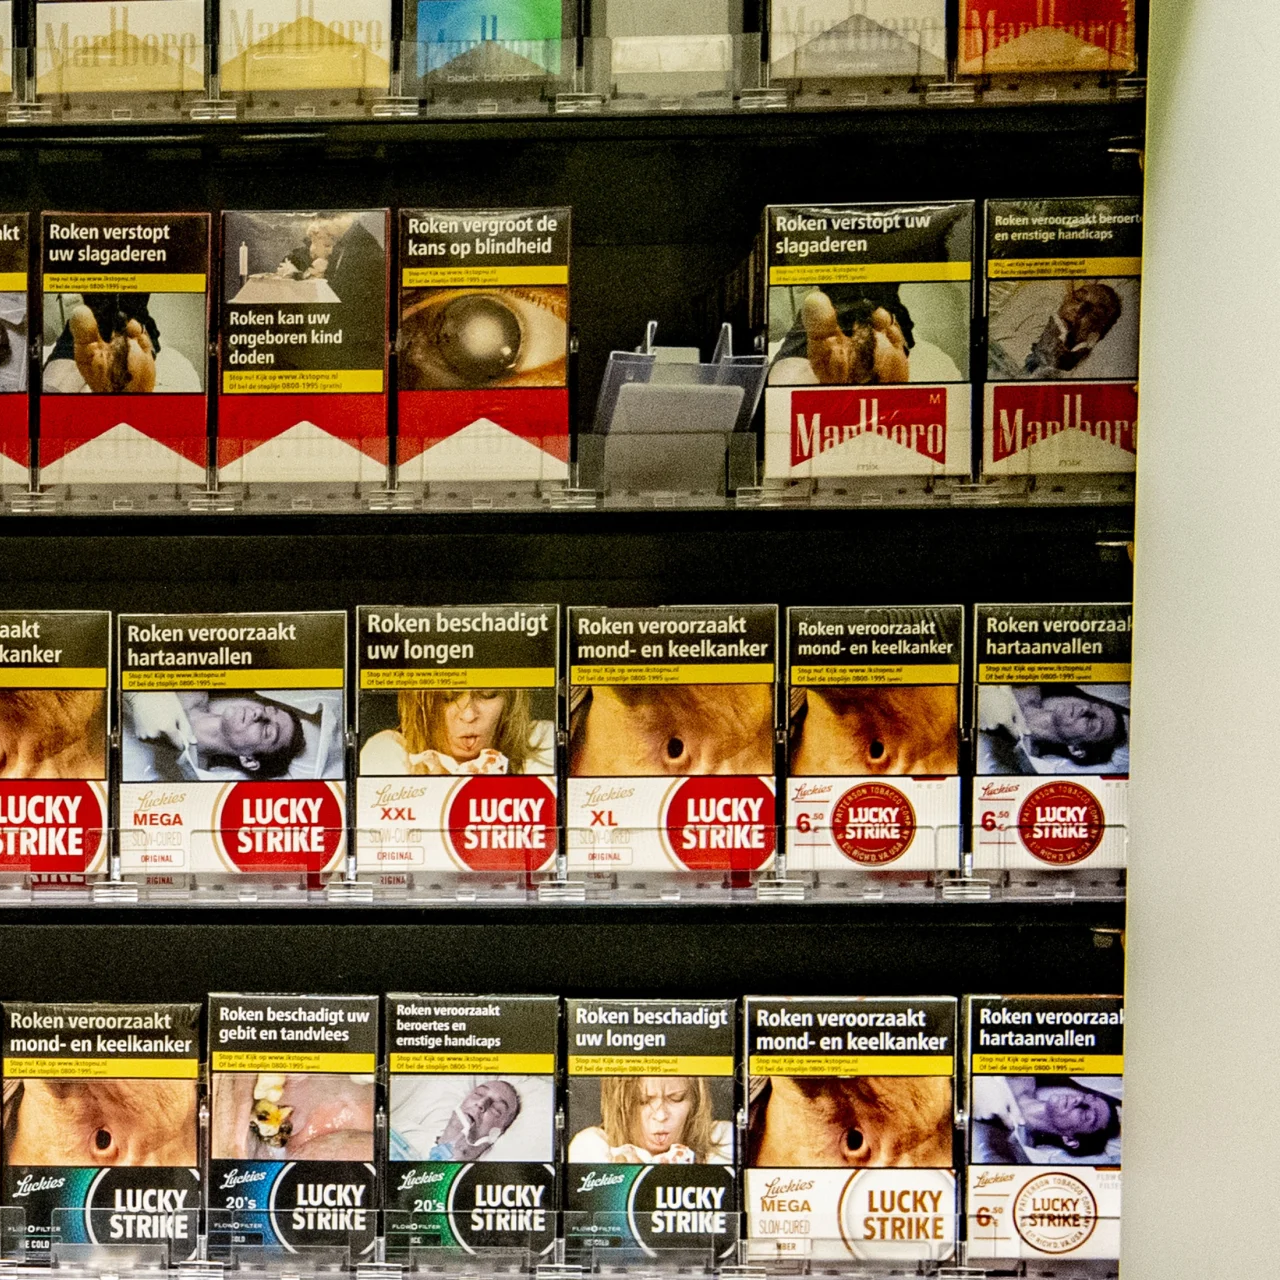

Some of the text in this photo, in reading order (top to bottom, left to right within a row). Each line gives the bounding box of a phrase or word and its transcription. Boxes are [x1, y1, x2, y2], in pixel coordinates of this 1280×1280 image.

[775, 213, 932, 235] Roken verstopt uw
[776, 236, 867, 257] slagaderen
[230, 310, 330, 325] Roken kan uw
[230, 329, 342, 348] ongeboren kind
[230, 350, 274, 364] doden
[795, 399, 944, 457] Marlboro
[133, 812, 184, 828] MEGA
[590, 810, 618, 827] XL
[397, 1004, 500, 1016] Roken veroorzaakt
[397, 1019, 466, 1031] beroertes en
[396, 1035, 500, 1049] ernstige handicaps
[225, 1195, 256, 1211] 20's
[297, 1183, 365, 1207] LUCKY
[760, 1199, 813, 1214] MEGA
[292, 1207, 367, 1232] STRIKE
[758, 1220, 811, 1236] SLOW-CURED
